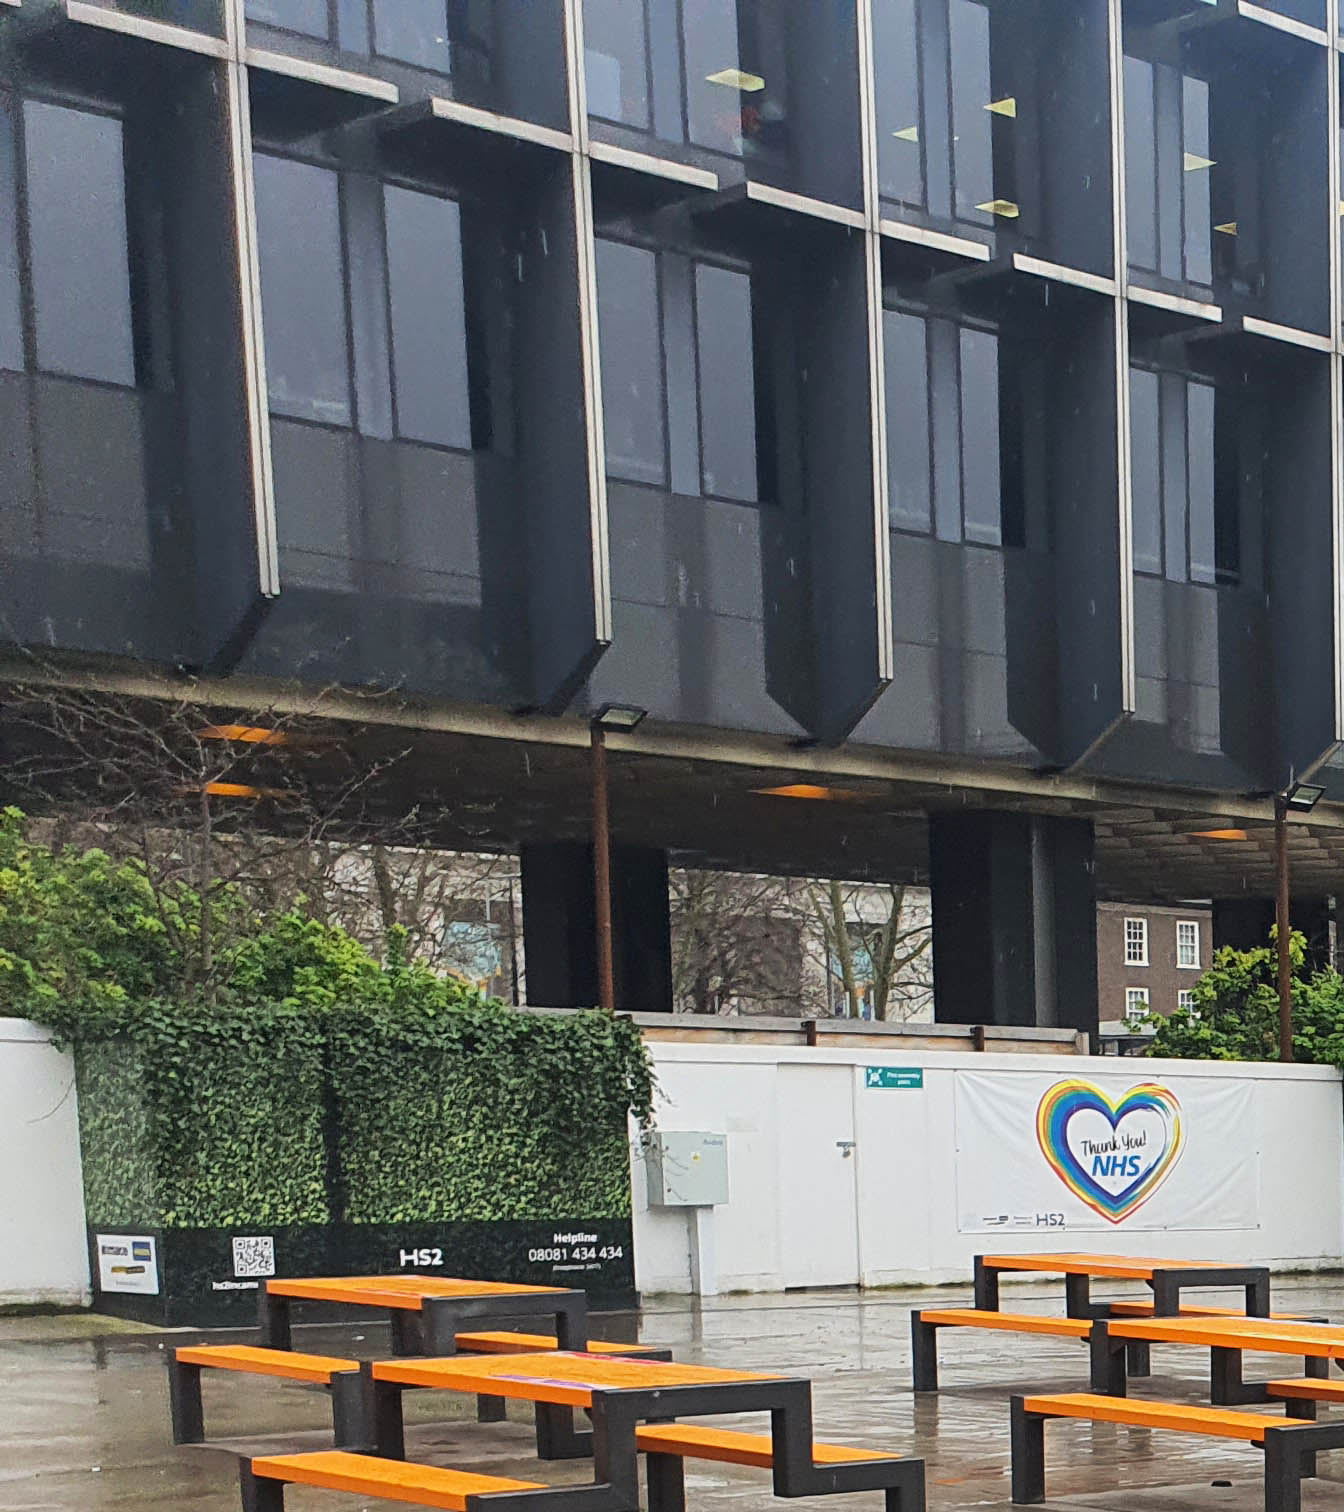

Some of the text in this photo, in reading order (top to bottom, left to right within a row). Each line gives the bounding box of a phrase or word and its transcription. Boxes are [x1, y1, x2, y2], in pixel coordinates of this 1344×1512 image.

[1081, 1130, 1147, 1156] Thank You!
[1092, 1156, 1142, 1176] NHS
[1036, 1214, 1065, 1226] HS2
[554, 1233, 597, 1243] Helpline
[400, 1249, 443, 1266] HS2
[529, 1247, 623, 1262] 08081 434 434
